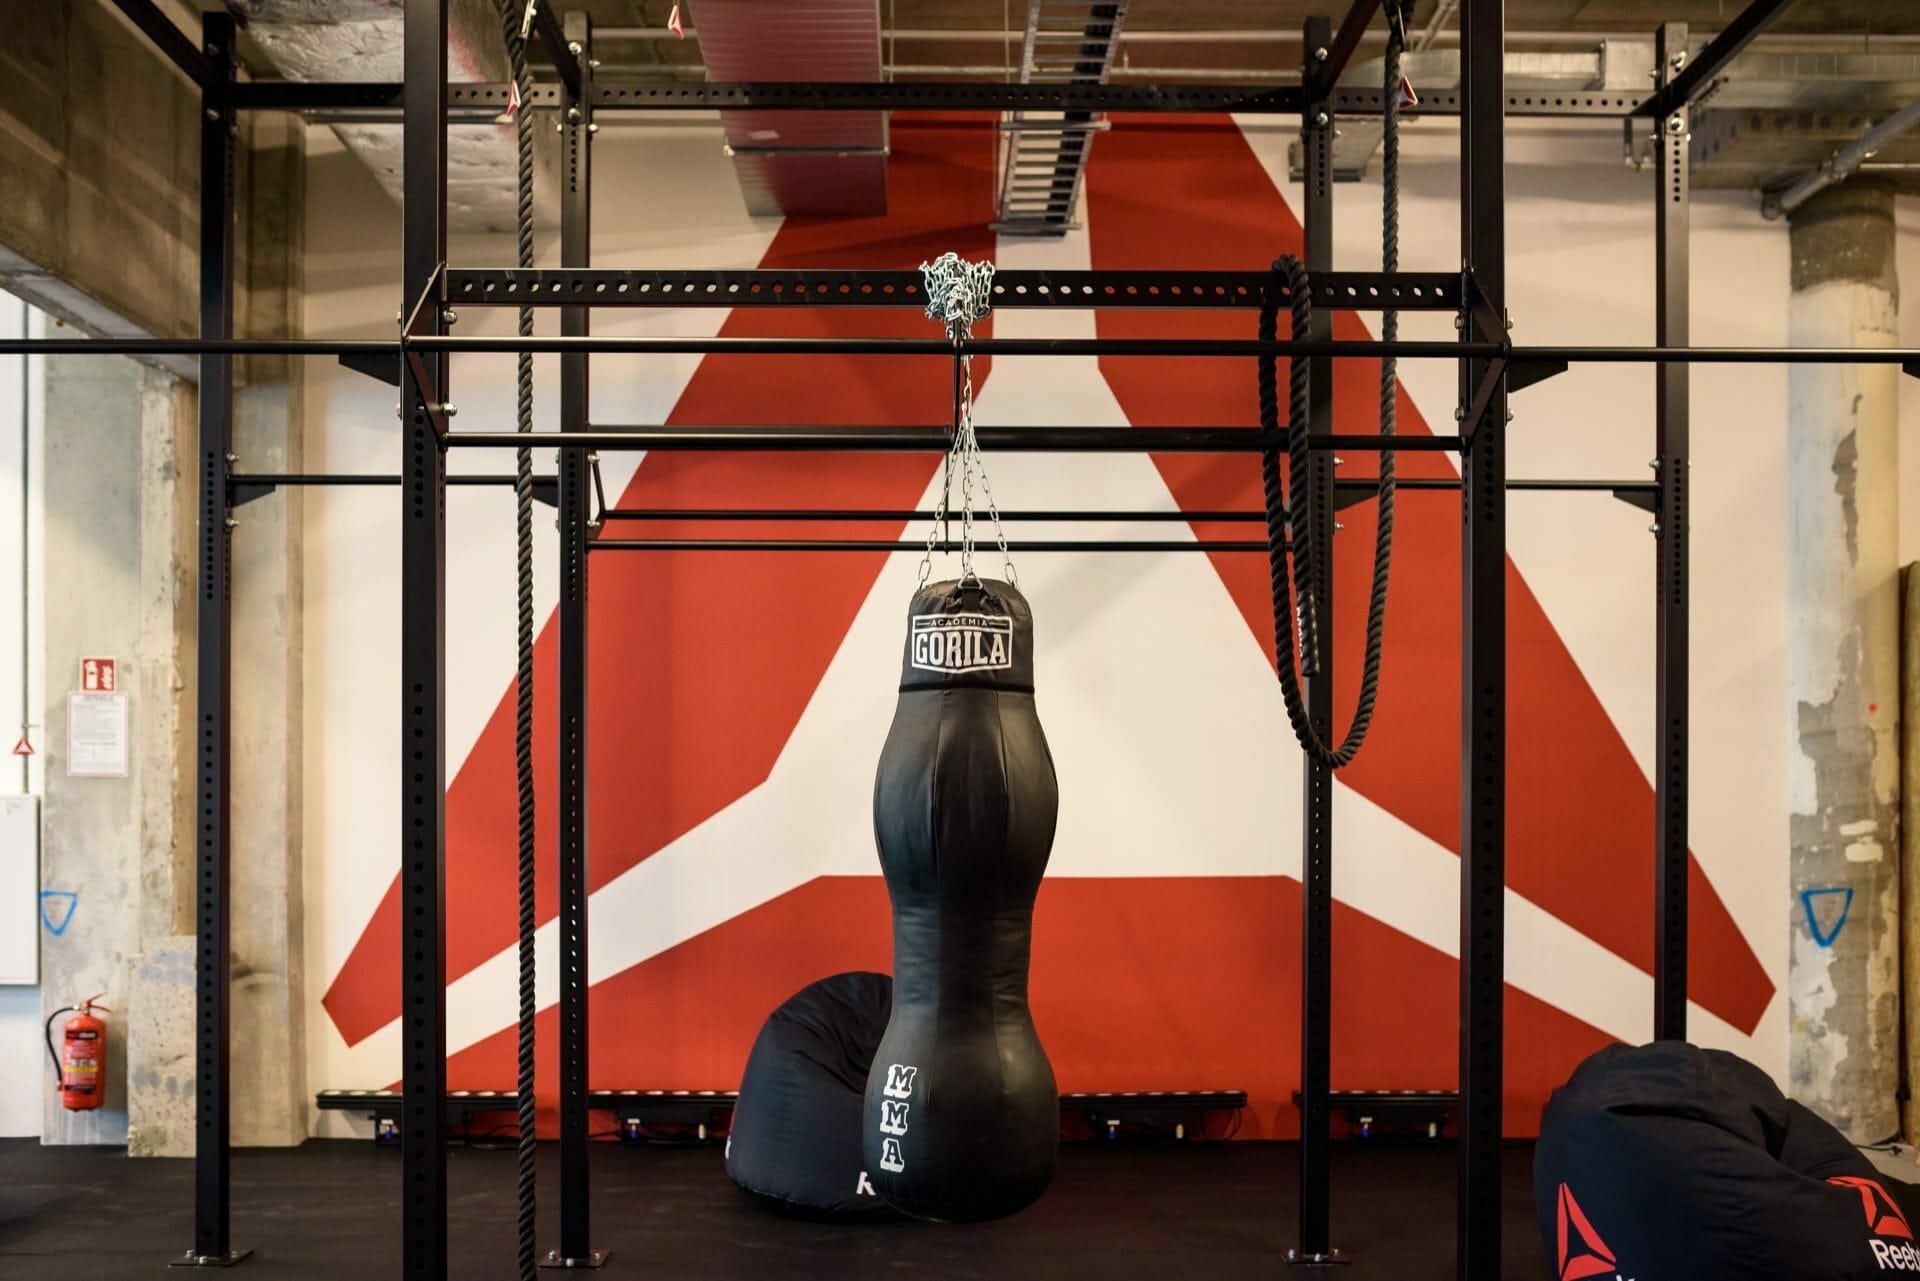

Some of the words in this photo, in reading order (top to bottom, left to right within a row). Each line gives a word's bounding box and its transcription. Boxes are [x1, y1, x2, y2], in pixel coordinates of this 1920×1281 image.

[931, 618, 987, 627] ACADEMIA
[915, 630, 1007, 668] GORILA
[880, 1064, 918, 1173] MMA
[1869, 1239, 1920, 1272] Reeb
